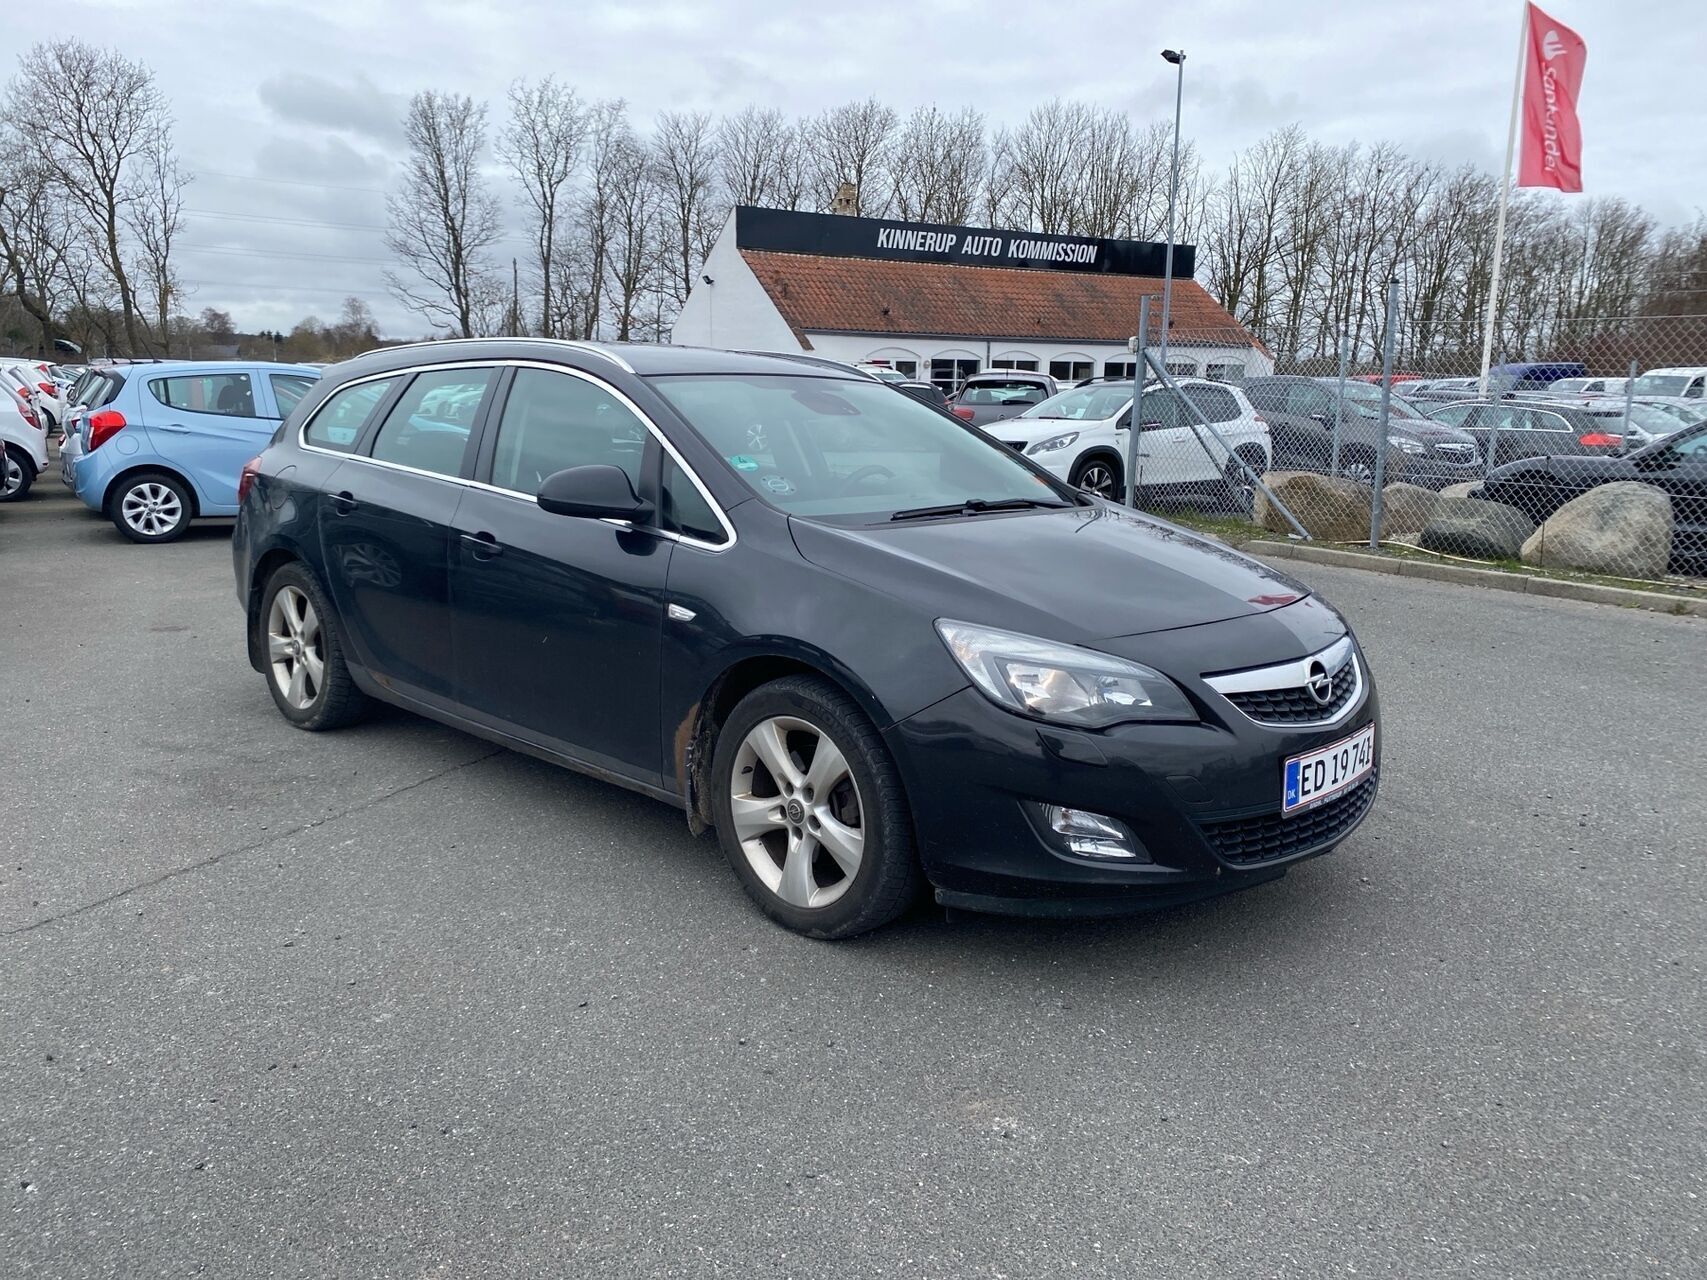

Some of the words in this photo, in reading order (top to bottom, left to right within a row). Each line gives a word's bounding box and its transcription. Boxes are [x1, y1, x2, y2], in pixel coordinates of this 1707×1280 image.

[877, 228, 957, 253] KINNERUP
[961, 235, 1002, 257] AUTO
[1008, 239, 1098, 264] KOMMISSION
[1301, 759, 1326, 796] ED
[1331, 748, 1349, 785] 19
[1287, 789, 1296, 800] DK
